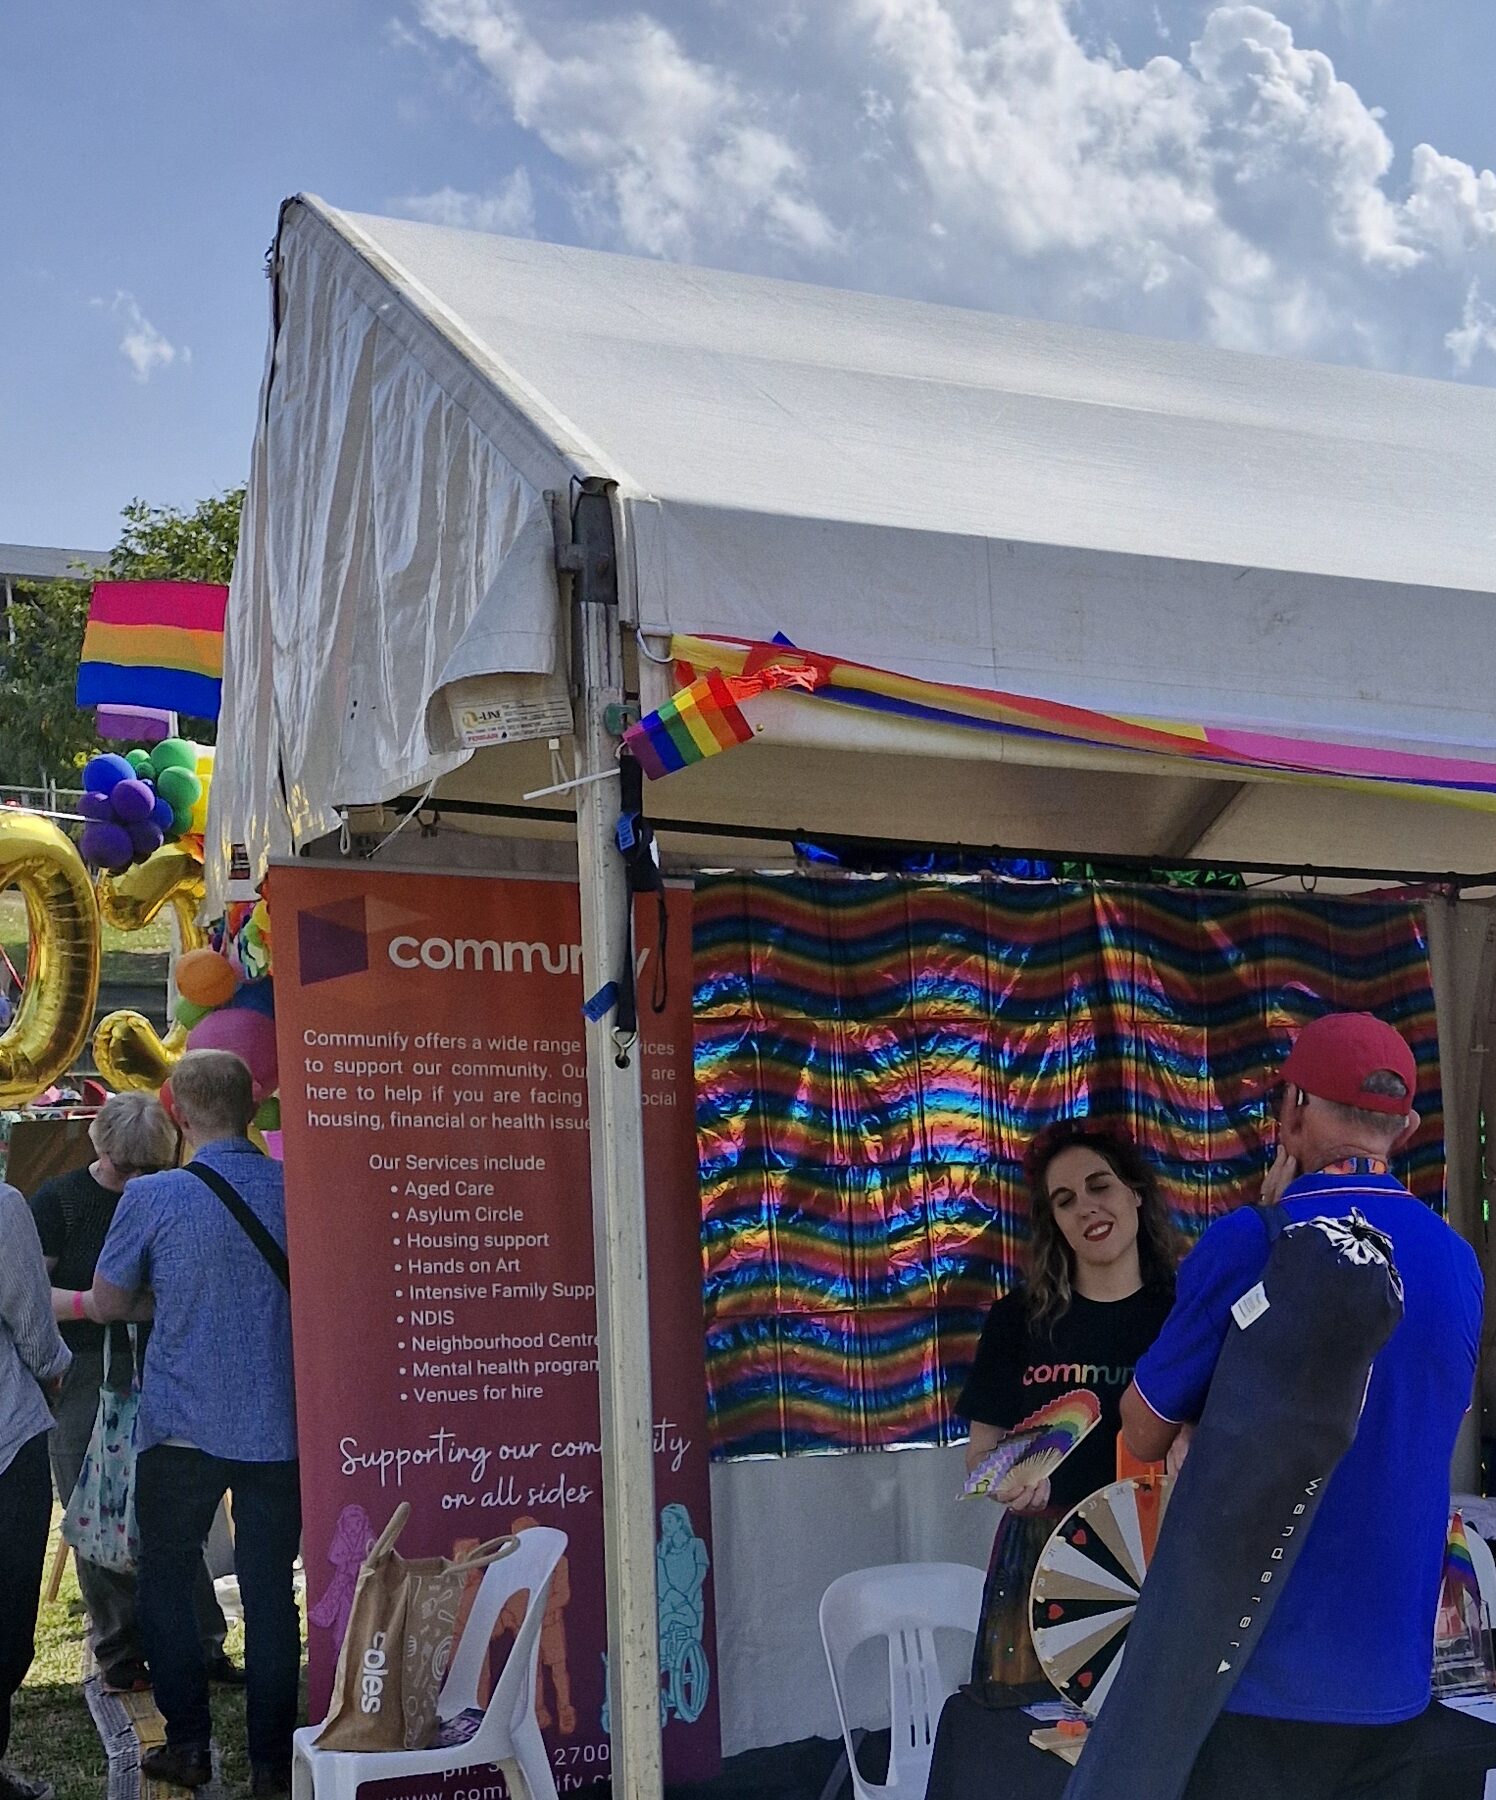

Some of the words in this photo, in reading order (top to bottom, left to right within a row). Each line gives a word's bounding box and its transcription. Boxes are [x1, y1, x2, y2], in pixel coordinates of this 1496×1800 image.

[304, 1029, 409, 1051] Communify
[414, 1034, 467, 1050] offers
[472, 1039, 481, 1050] a
[488, 1036, 528, 1051] wide
[533, 1040, 581, 1056] range
[304, 1058, 324, 1073] to
[334, 1060, 402, 1076] support
[413, 1063, 442, 1075] our
[451, 1062, 552, 1080] community.
[562, 1064, 586, 1078] Ou
[652, 1067, 676, 1080] are
[306, 1084, 346, 1099] here
[357, 1086, 375, 1100] to
[384, 1086, 422, 1104] help
[432, 1087, 443, 1101] if
[453, 1090, 483, 1105] you
[494, 1090, 520, 1103] are
[530, 1087, 583, 1107] facing
[642, 1091, 676, 1106] ocial
[308, 1111, 385, 1130] housing,
[390, 1112, 467, 1129] financial
[470, 1116, 487, 1128] or
[492, 1113, 545, 1129] health
[550, 1115, 591, 1130] issue
[369, 1155, 401, 1170] Our
[406, 1155, 479, 1171] Services
[483, 1155, 546, 1171] include
[405, 1182, 450, 1200] Aged
[455, 1181, 495, 1196] Care
[406, 1207, 470, 1226] Asylum
[475, 1207, 524, 1223] Circle
[407, 1233, 479, 1252] Housing
[484, 1233, 549, 1251] support
[408, 1259, 465, 1275] Hands
[469, 1261, 491, 1273] on
[495, 1258, 521, 1273] Art
[409, 1284, 487, 1300] Intensive
[492, 1283, 549, 1302] Family
[552, 1281, 595, 1300] Supp
[410, 1310, 455, 1326] NDIS
[412, 1333, 544, 1354] Neighbourhood
[413, 1360, 472, 1378] Mental
[477, 1359, 530, 1376] health
[414, 1387, 478, 1403] Venues
[483, 1384, 507, 1401] for
[511, 1384, 544, 1400] hire
[339, 1427, 492, 1487] Supporting
[499, 1441, 543, 1461] our
[551, 1417, 691, 1472] comity
[441, 1489, 475, 1511] on
[481, 1477, 521, 1507] all
[527, 1474, 594, 1509] sides
[554, 1743, 610, 1766] 2700
